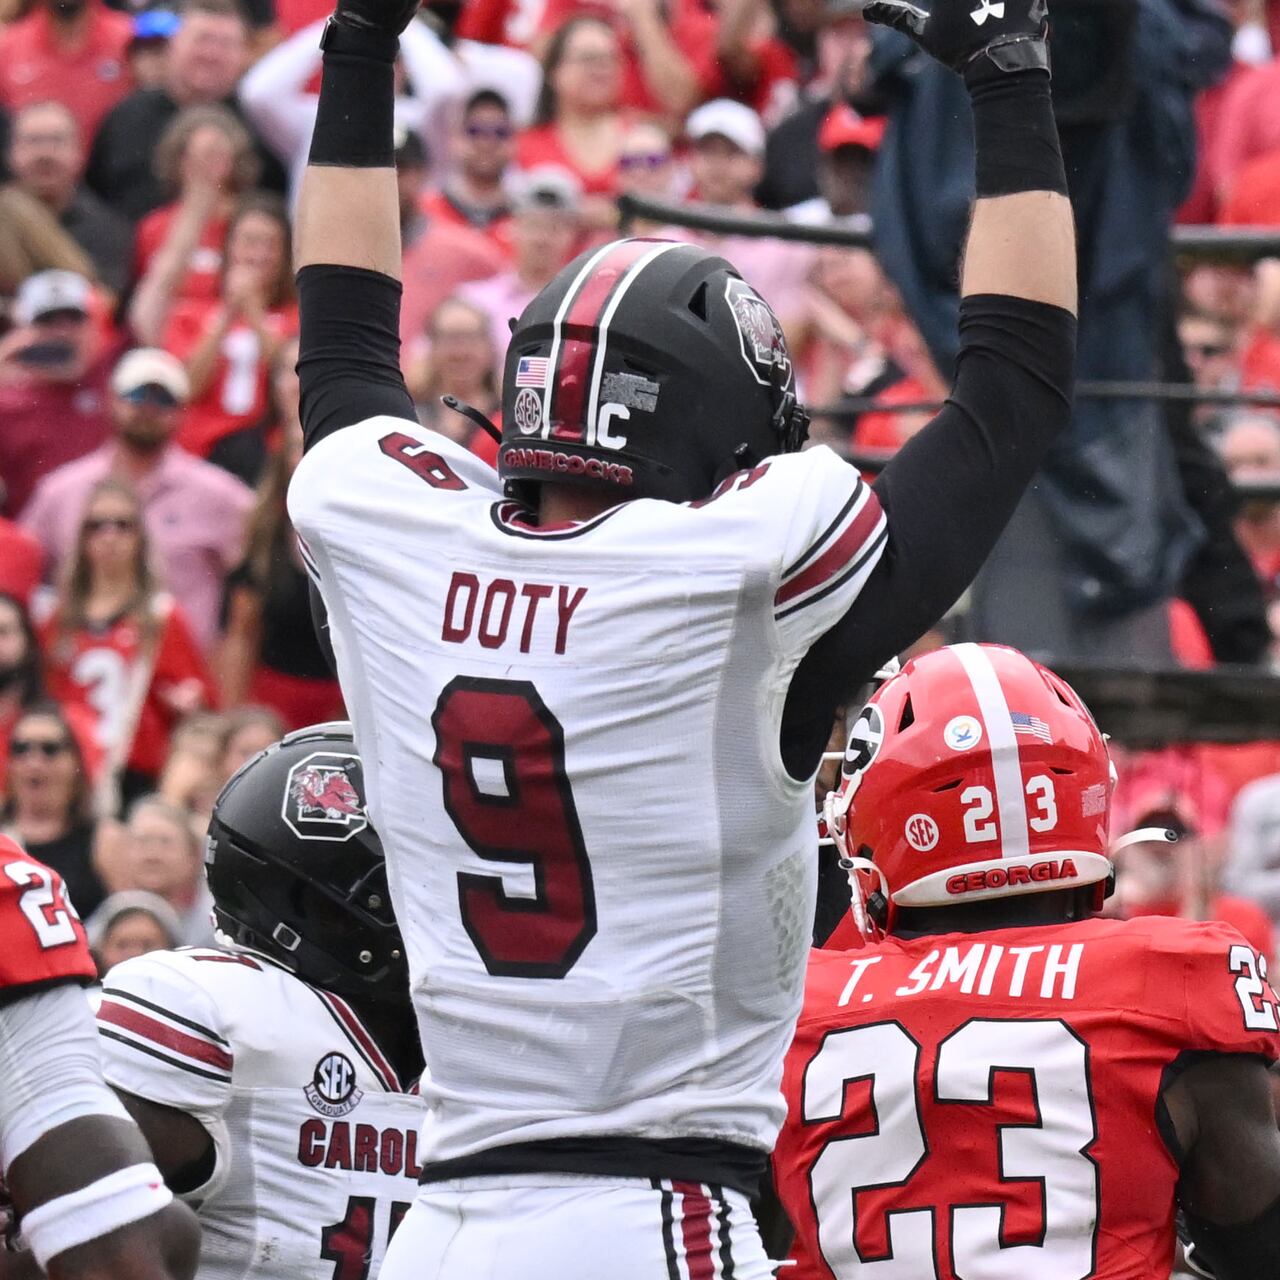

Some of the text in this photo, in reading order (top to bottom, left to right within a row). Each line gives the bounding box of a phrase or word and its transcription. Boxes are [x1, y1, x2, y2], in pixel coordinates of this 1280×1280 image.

[597, 403, 631, 450] C
[503, 448, 634, 486] GAMECOCKS
[441, 571, 588, 655] DOTY
[432, 674, 599, 979] 9
[907, 816, 936, 848] SEC
[945, 858, 1078, 894] GEORGIA
[4, 860, 80, 951] 2
[837, 943, 1084, 1006] T. SMITH
[316, 1054, 354, 1101] SEC
[297, 1118, 422, 1179] CAROL
